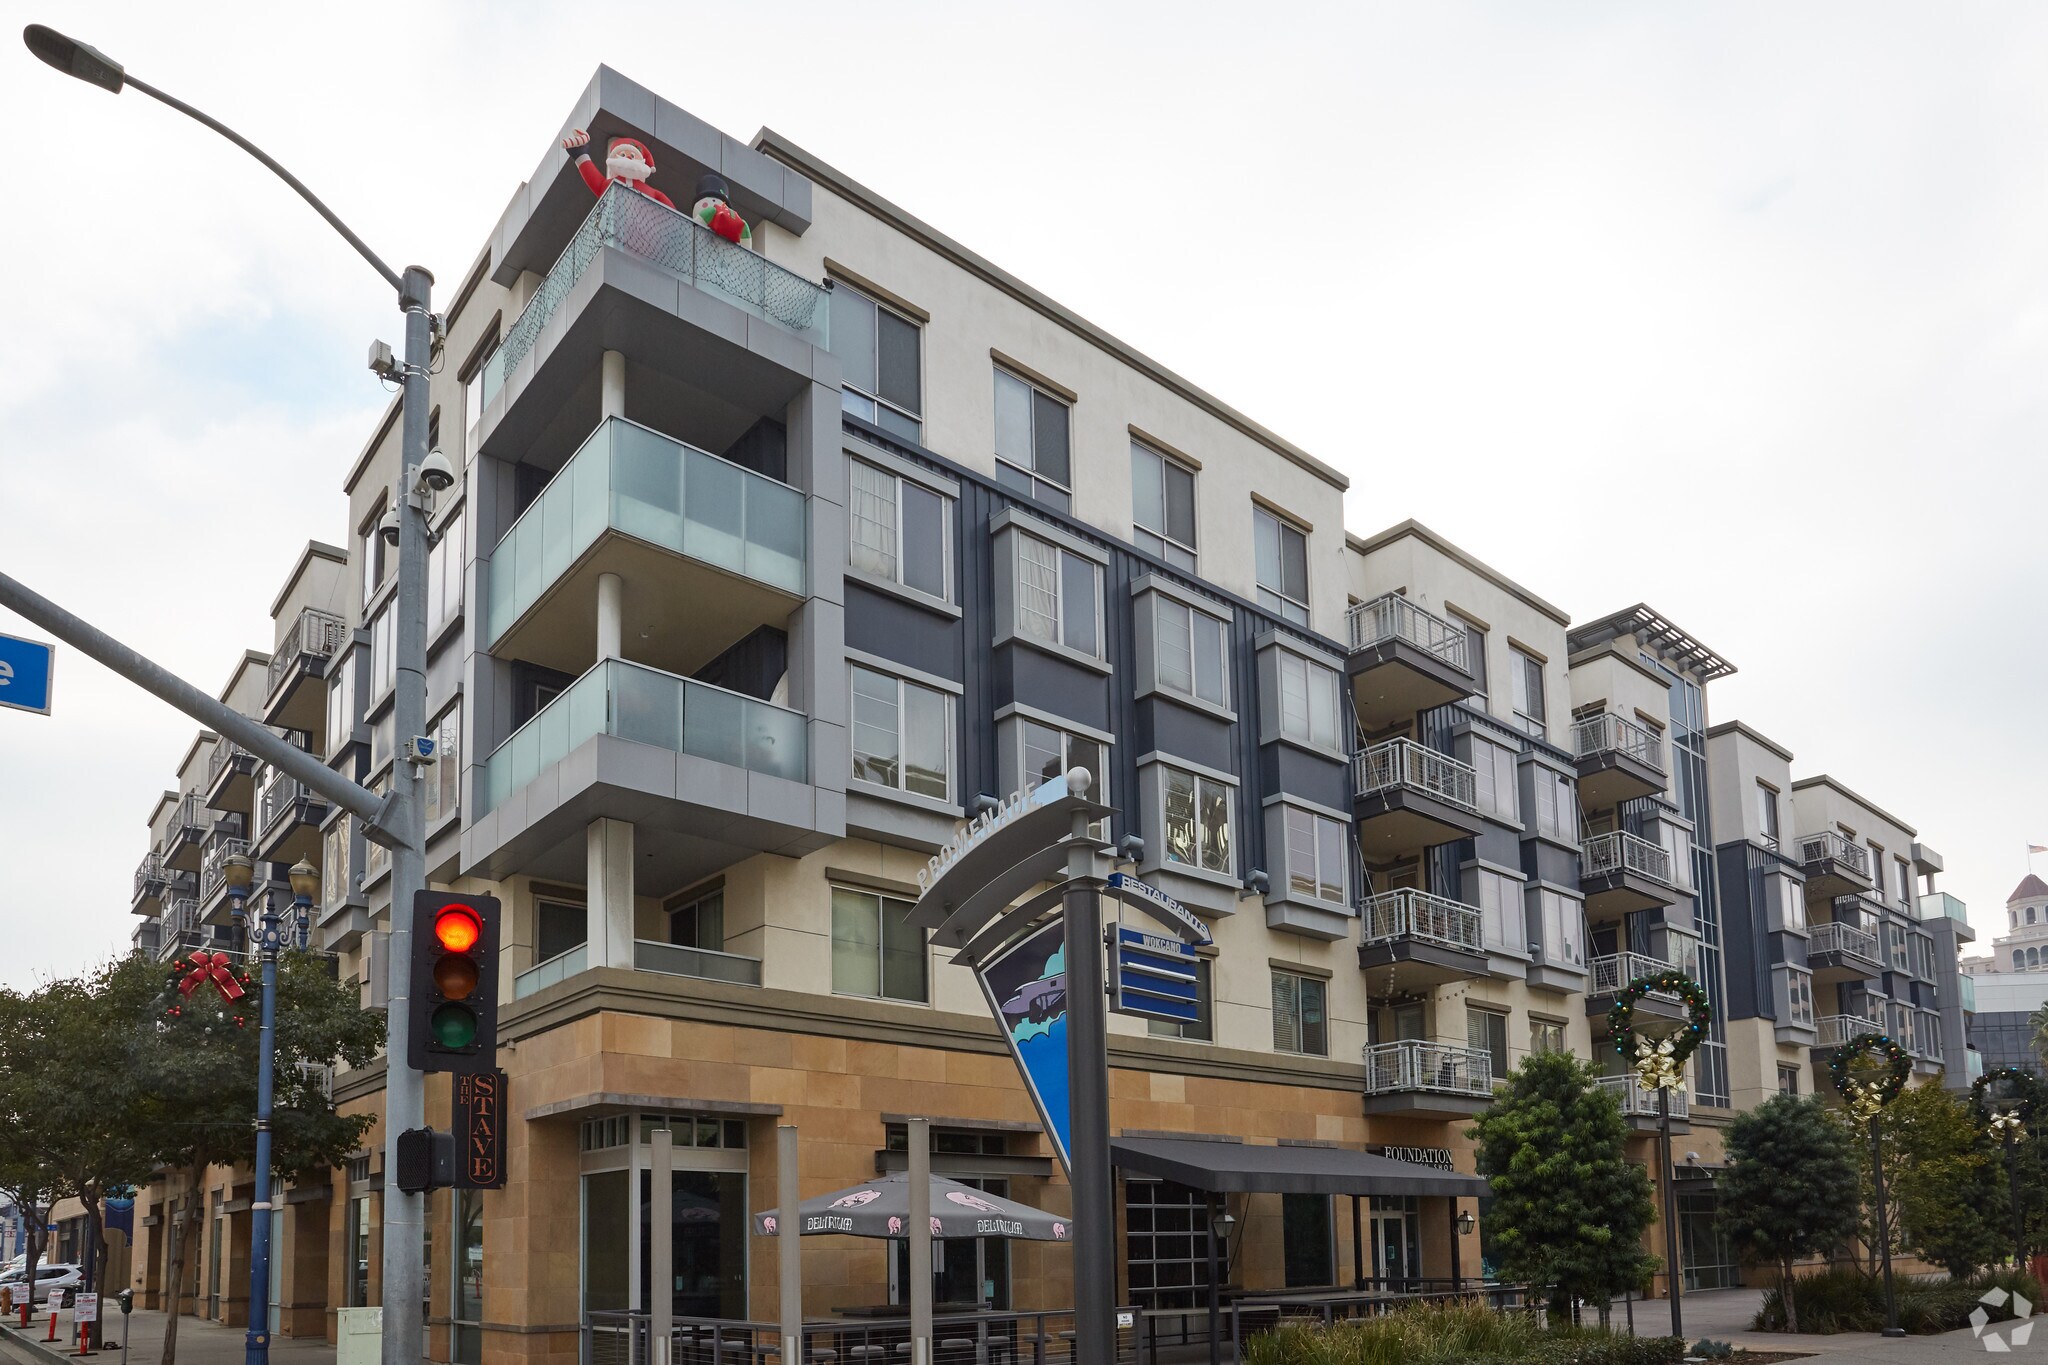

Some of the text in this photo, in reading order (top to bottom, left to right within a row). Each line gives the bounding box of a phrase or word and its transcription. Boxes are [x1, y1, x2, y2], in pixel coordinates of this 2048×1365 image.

[916, 781, 1042, 893] PROMENADE
[1122, 875, 1208, 934] RESTAURANTS
[1142, 934, 1181, 953] WOKCANO
[459, 1076, 470, 1105] THE
[472, 1076, 494, 1176] STAVE
[1384, 1146, 1453, 1163] FOUNDATION
[807, 1216, 853, 1231] DELIRIUM
[977, 1219, 1023, 1235] DELIRIUM
